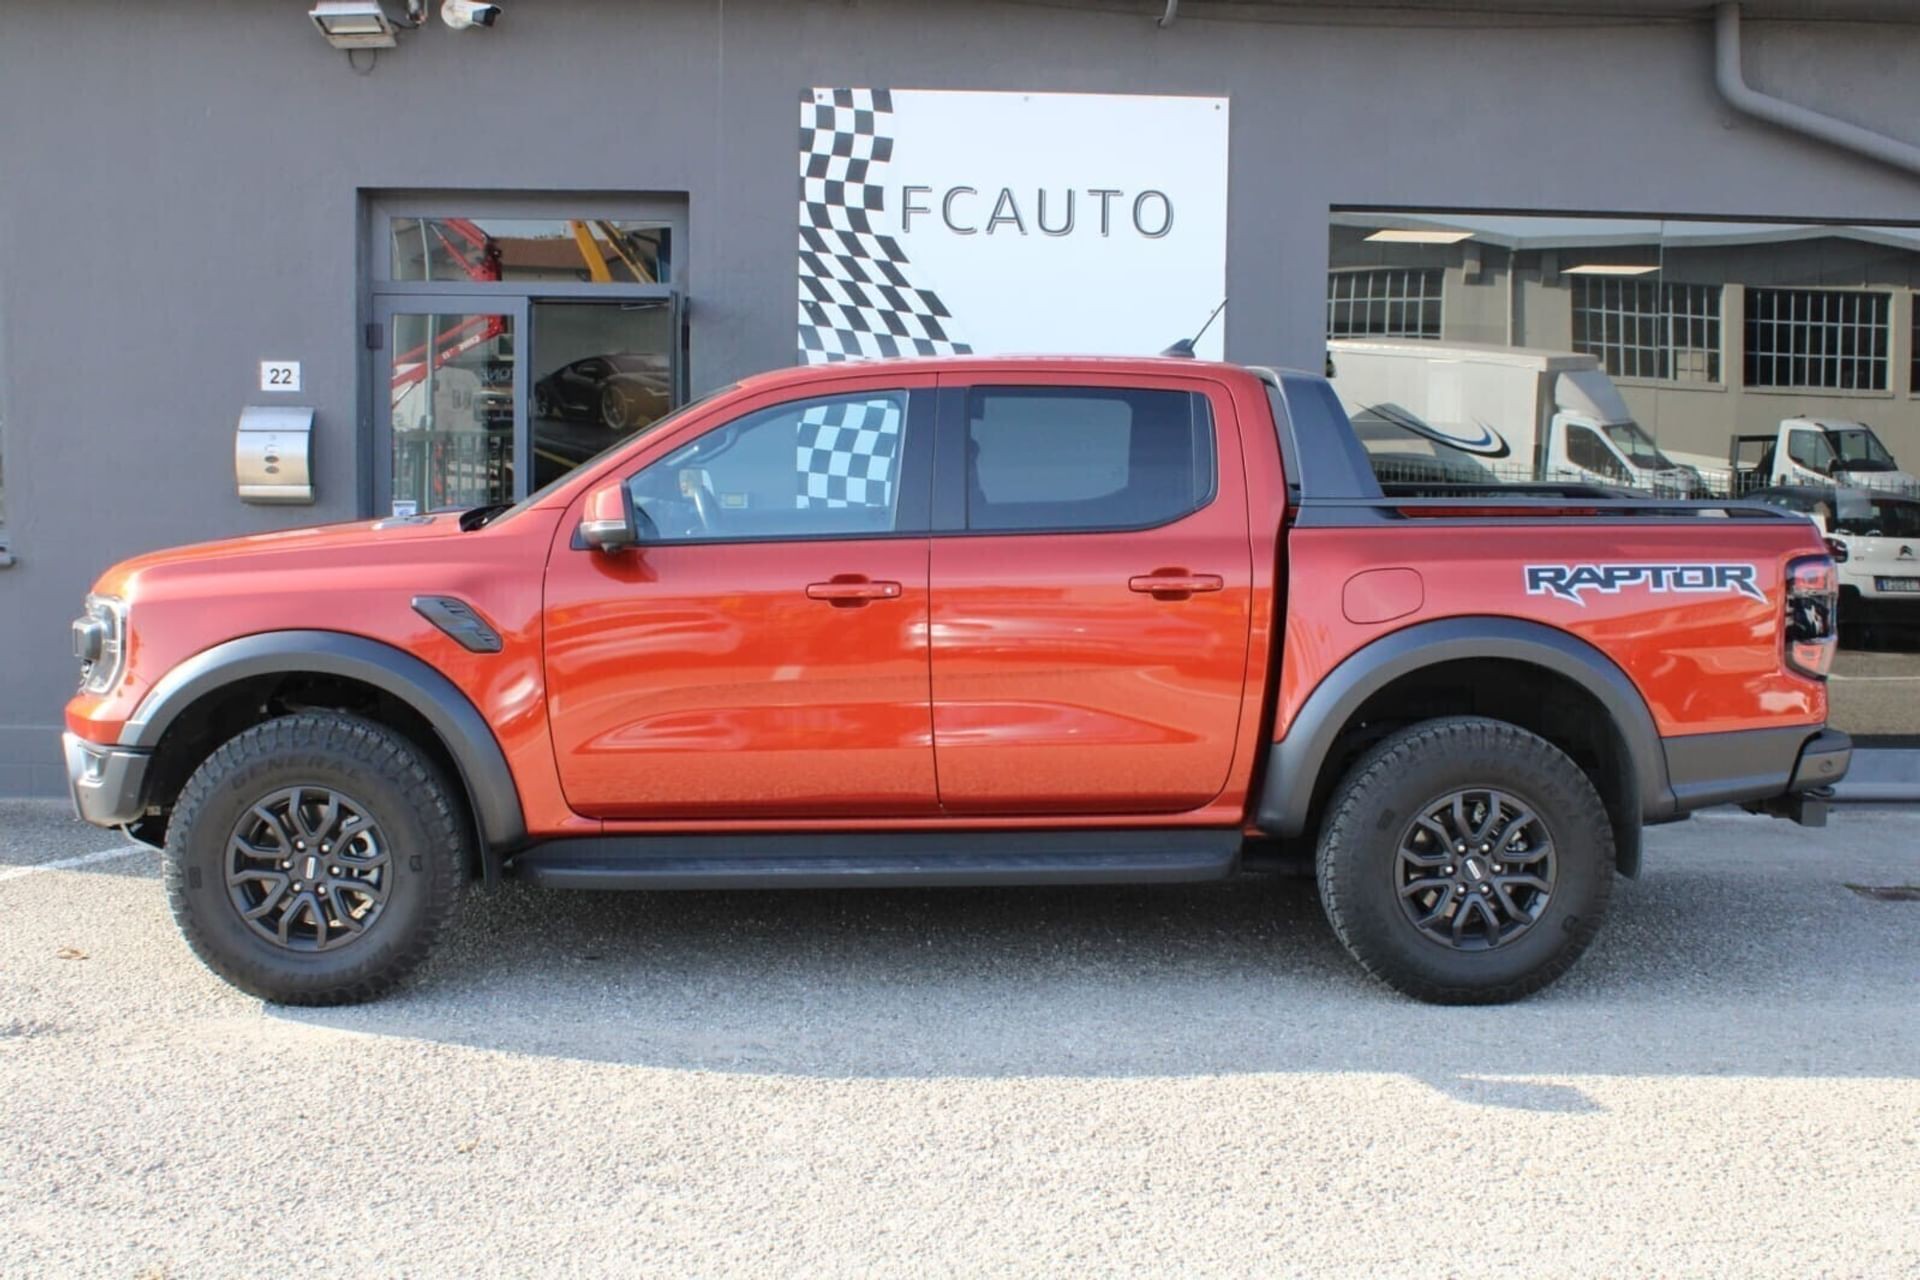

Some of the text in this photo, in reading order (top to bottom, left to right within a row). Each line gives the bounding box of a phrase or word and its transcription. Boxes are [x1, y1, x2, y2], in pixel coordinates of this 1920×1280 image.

[902, 184, 1175, 239] FCAUTO
[270, 368, 292, 385] 22
[1523, 562, 1769, 608] RAPTOR
